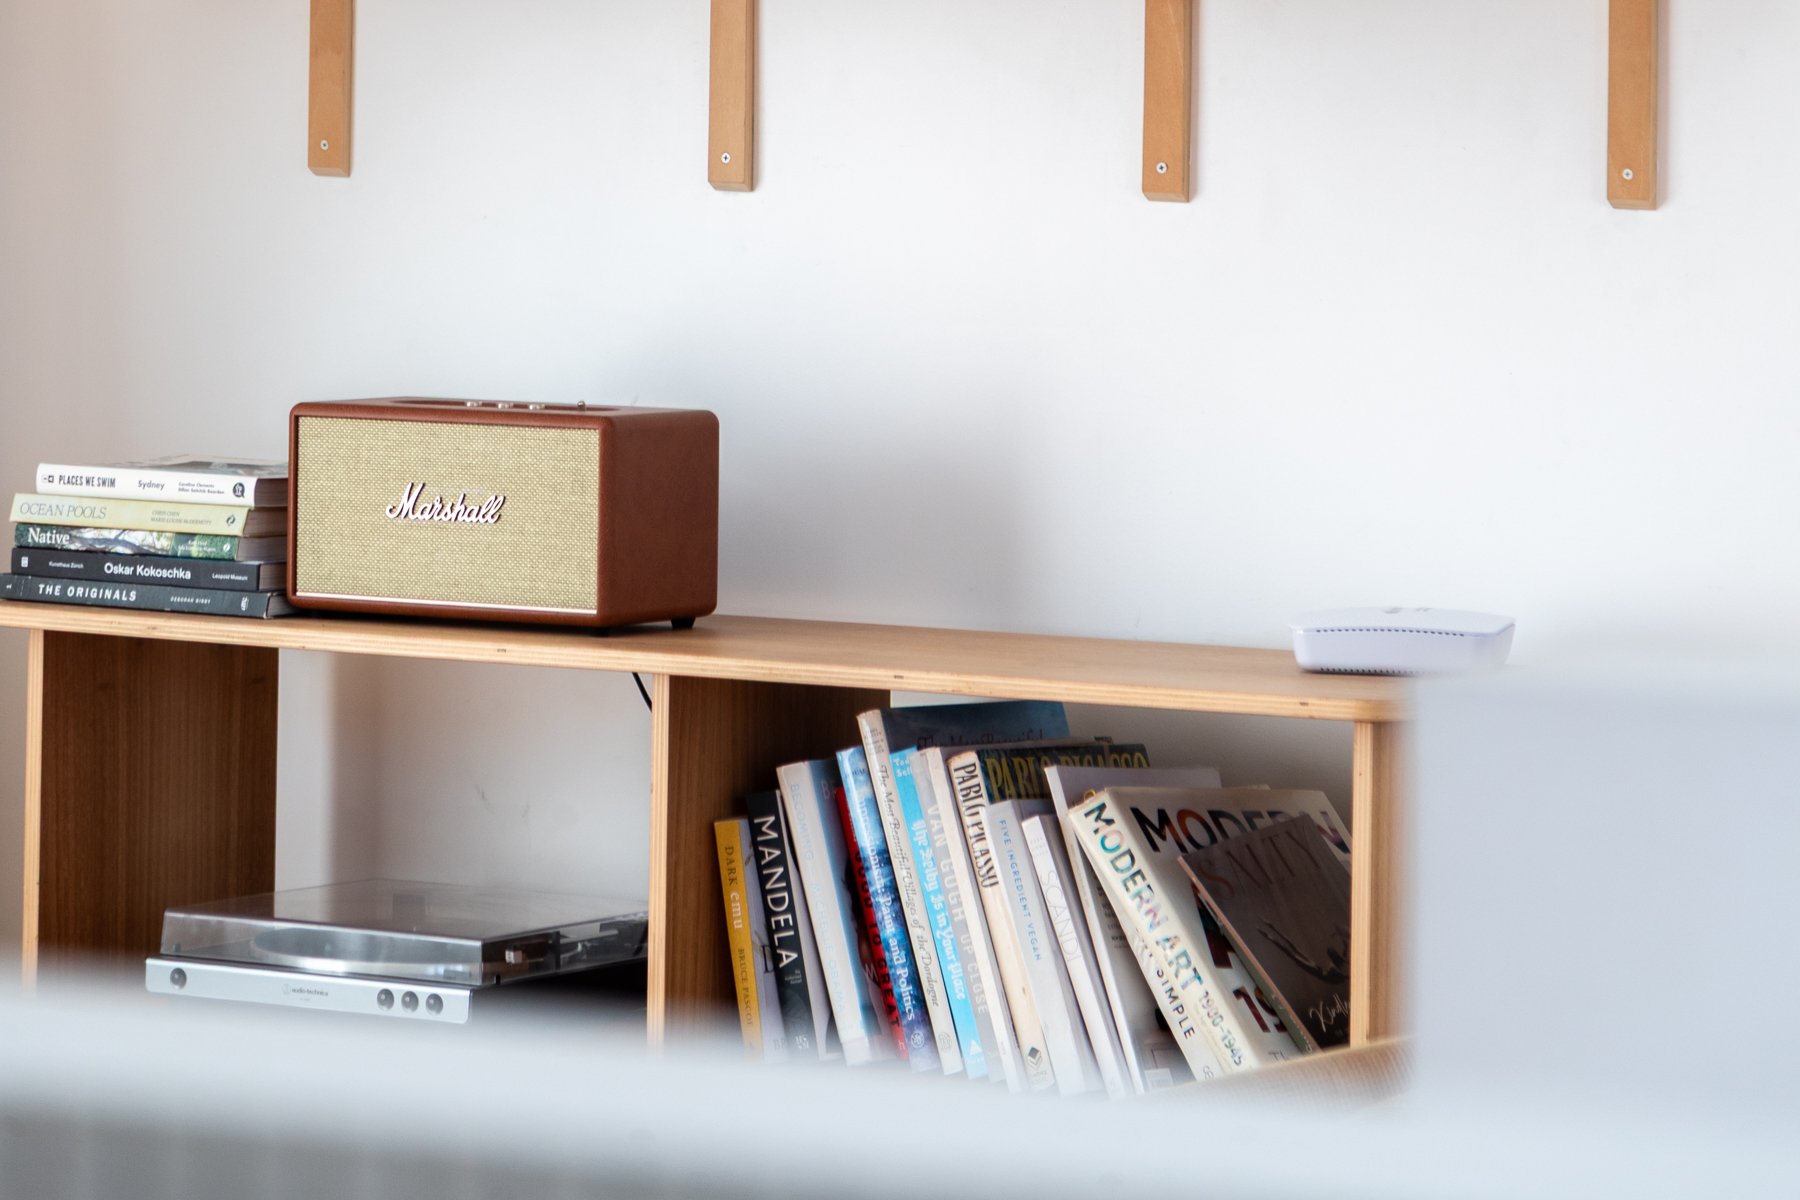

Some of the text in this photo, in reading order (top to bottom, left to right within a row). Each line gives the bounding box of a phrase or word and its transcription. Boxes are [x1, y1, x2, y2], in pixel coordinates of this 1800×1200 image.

[58, 475, 116, 488] PLACES WE SWIM
[137, 480, 165, 491] Sydney
[386, 481, 506, 523] Marshall
[19, 502, 107, 520] OCEAN POOLS
[27, 526, 70, 545] Native
[38, 584, 137, 601] THE ORIGINALS
[104, 562, 192, 580] Oskar Kokoschka
[953, 762, 1000, 889] PABLO PICASSO
[724, 846, 744, 930] DARK emu
[754, 815, 798, 968] MANDELA
[929, 805, 946, 848] VAN
[961, 933, 974, 954] UP
[968, 961, 987, 1015] CLOSE
[999, 820, 1041, 961] FIVE INGREDIENT VEGAN
[1040, 864, 1081, 957] SCANDI
[1084, 802, 1244, 1067] MODERN ART 1900-1945
[291, 987, 329, 996] audio-technica
[1156, 968, 1196, 1040] SIMPLE
